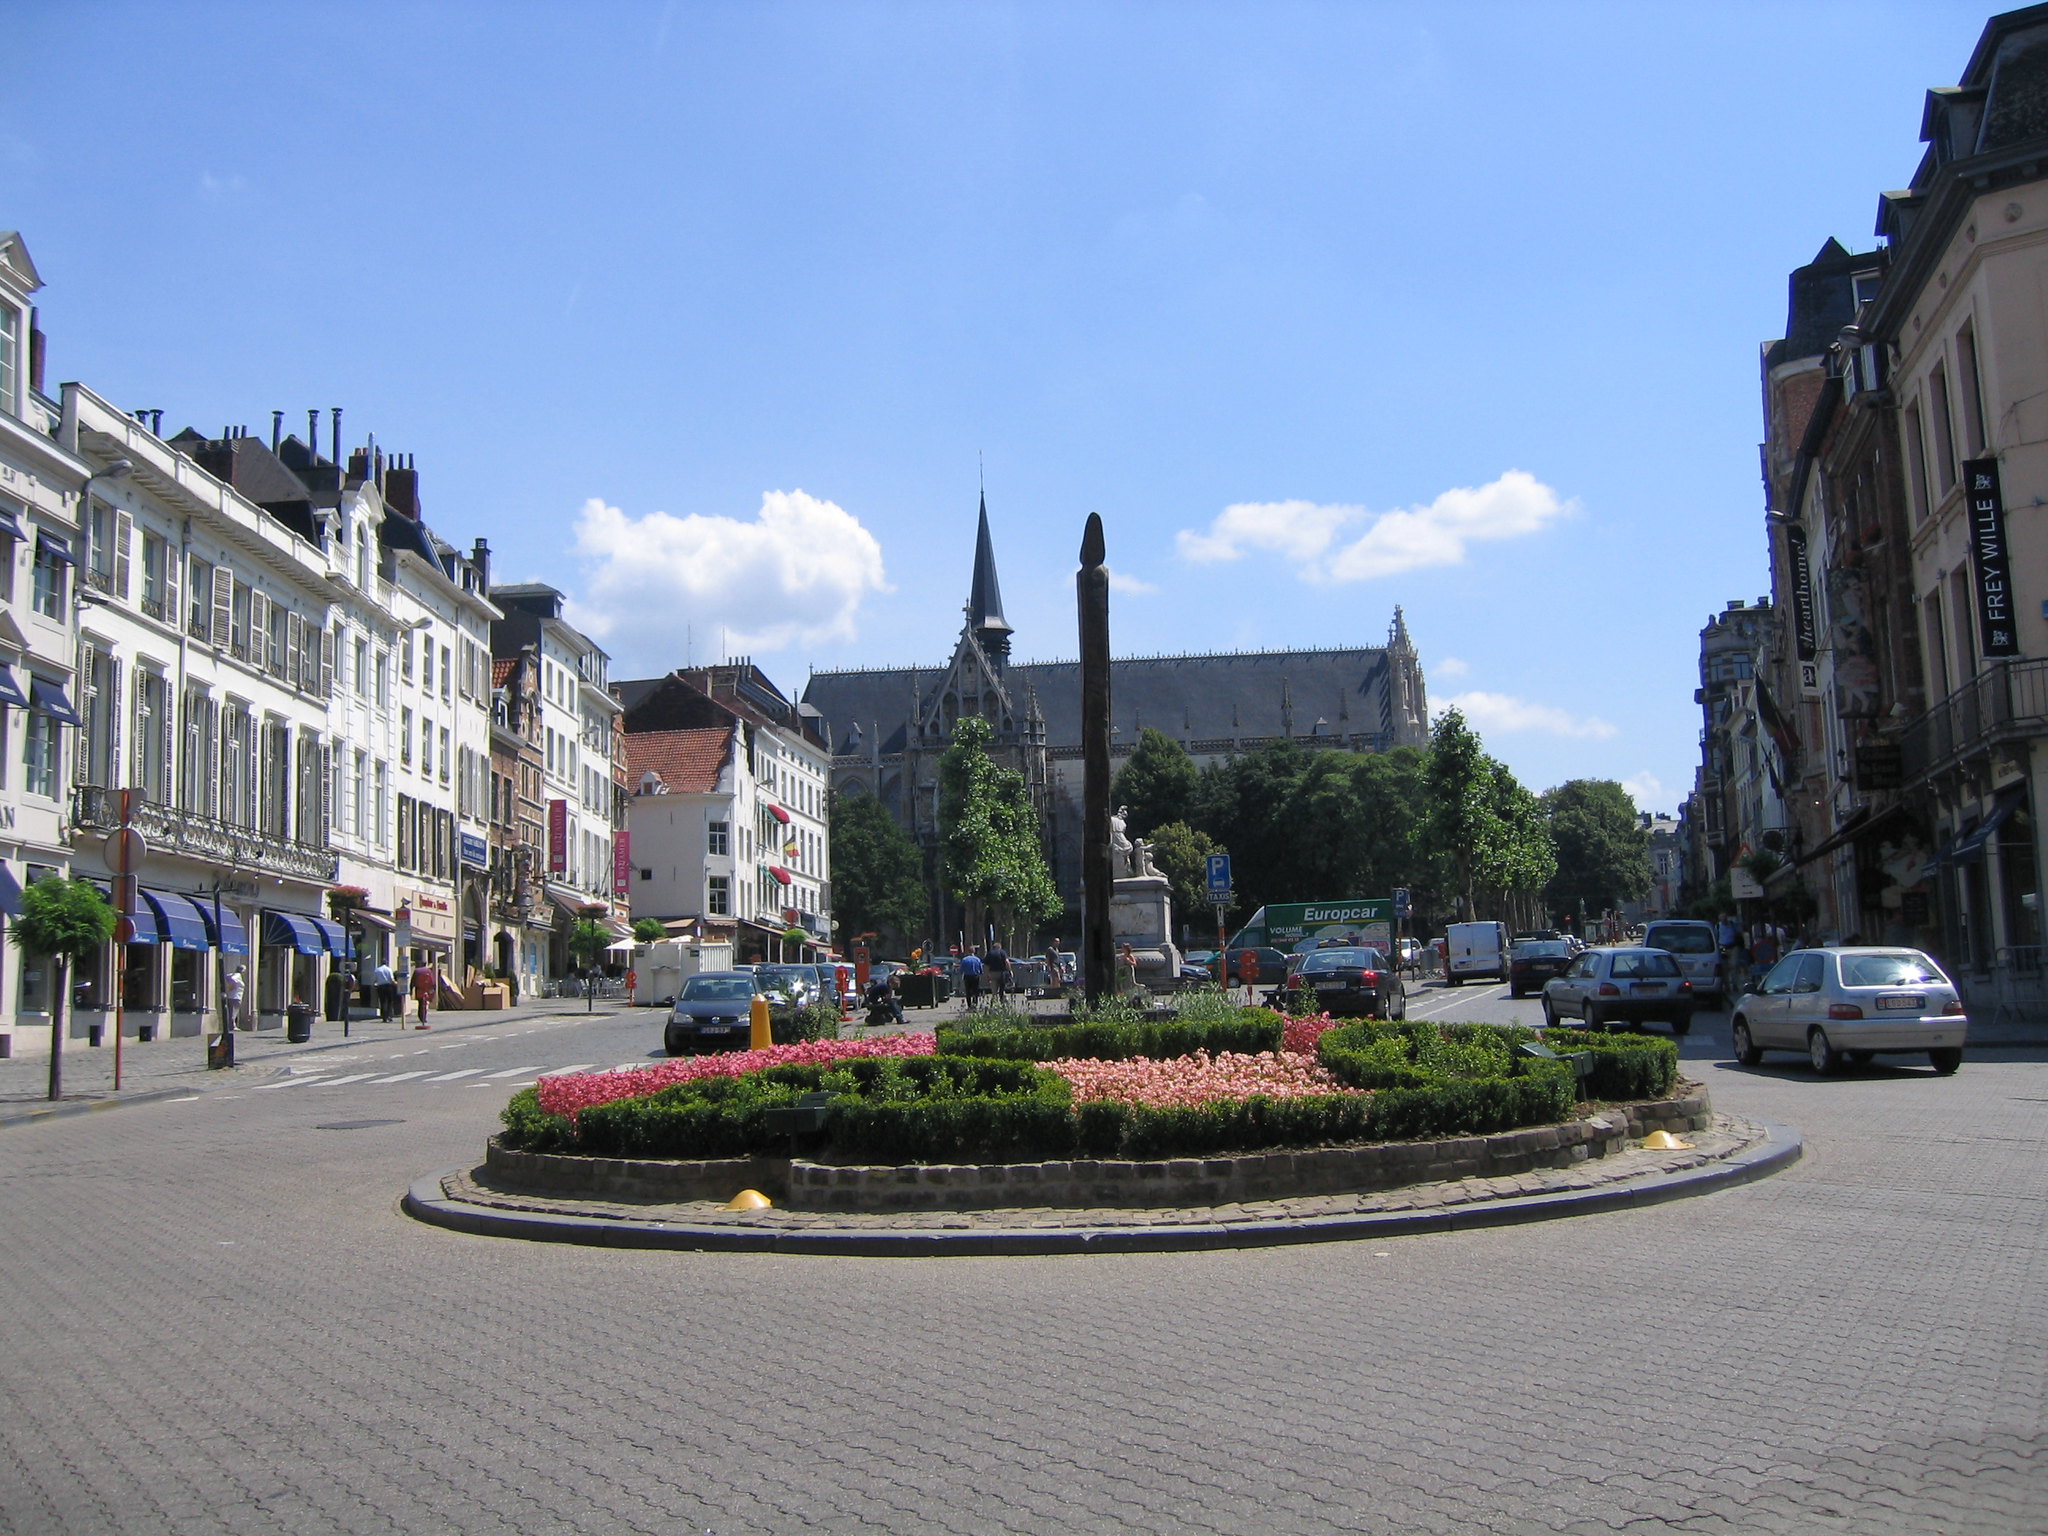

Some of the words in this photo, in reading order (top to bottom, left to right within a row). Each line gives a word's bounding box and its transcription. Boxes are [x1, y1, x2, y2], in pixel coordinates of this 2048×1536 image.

[1976, 499, 1999, 561] WILLE
[1984, 567, 2006, 620] FREY
[1211, 857, 1224, 875] P
[1208, 892, 1230, 901] TAXIS
[1395, 891, 1404, 902] P
[1303, 907, 1378, 923] Europcar
[1269, 926, 1304, 935] VOLUME
